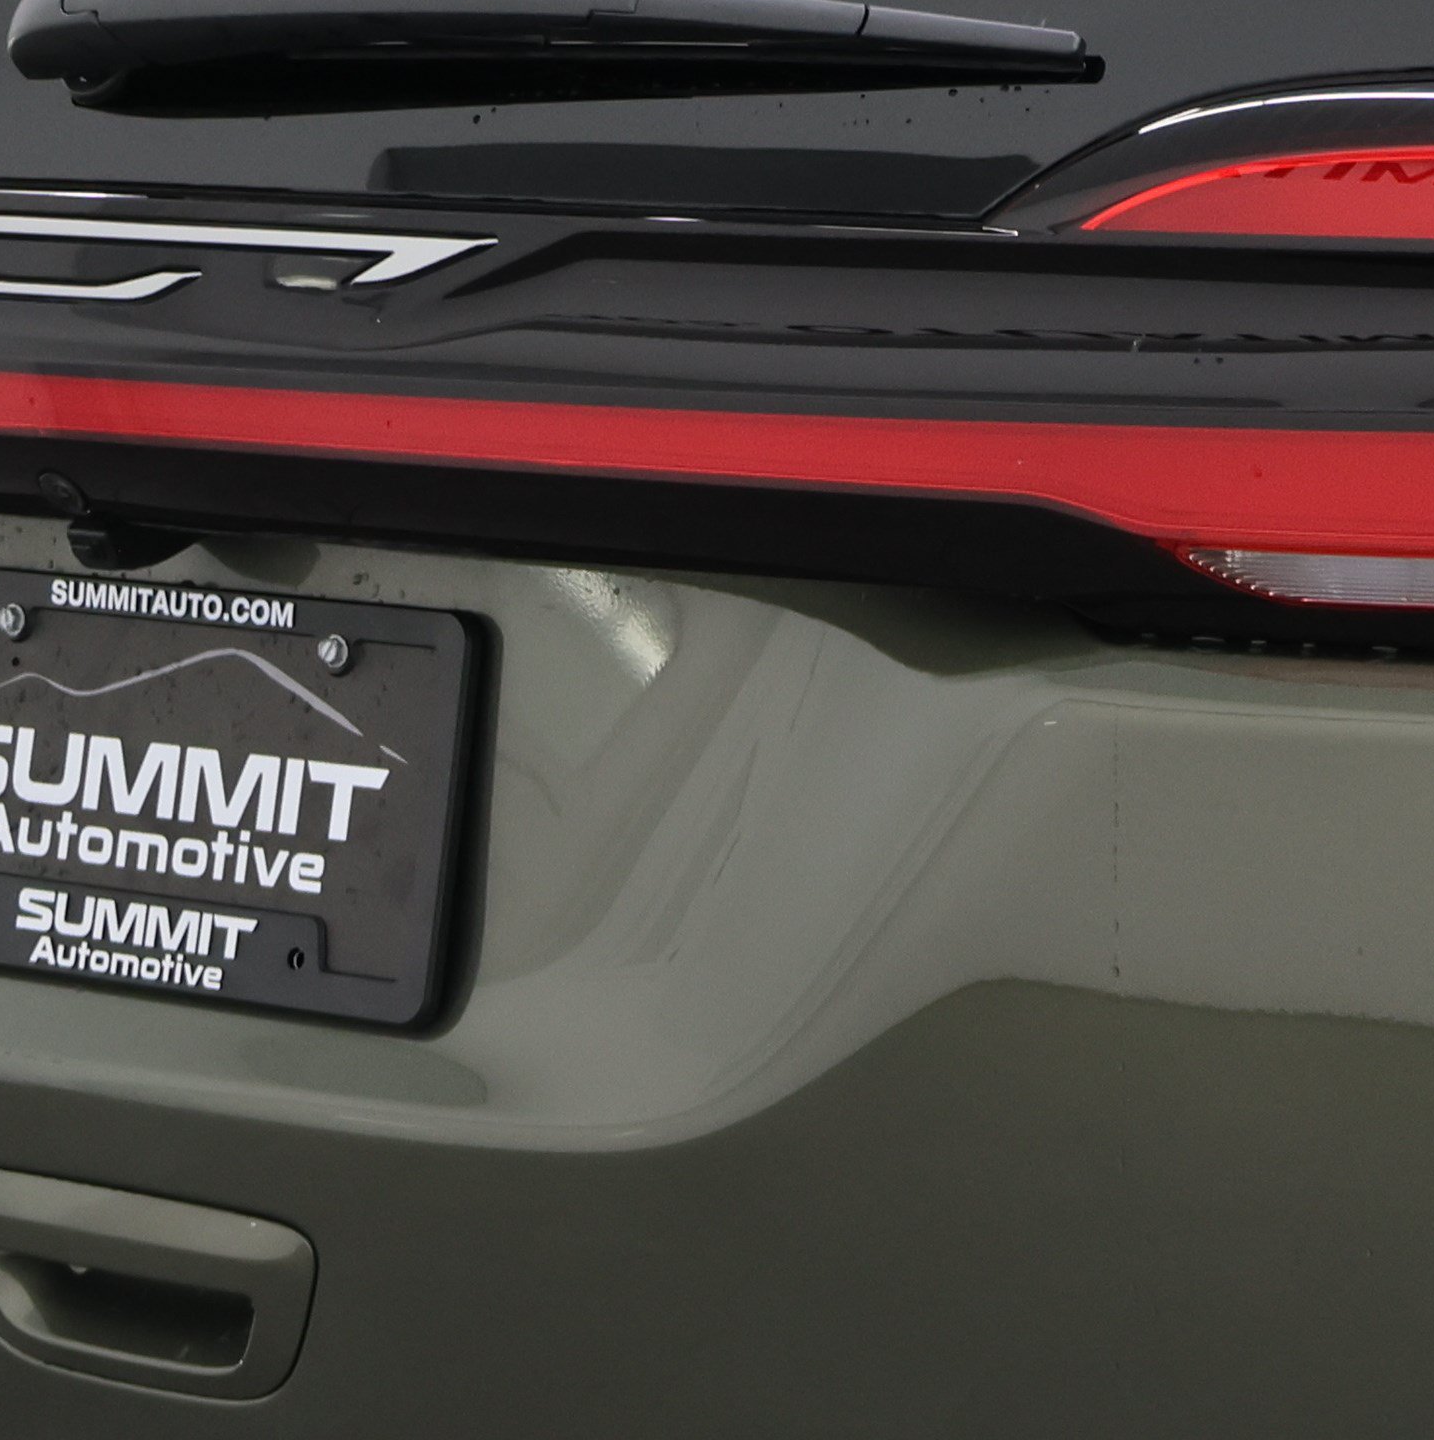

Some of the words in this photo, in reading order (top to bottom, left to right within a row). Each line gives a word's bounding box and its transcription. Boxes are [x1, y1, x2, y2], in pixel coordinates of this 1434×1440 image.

[50, 578, 295, 628] SUMMITAUTO.COM
[15, 887, 258, 961] SUMMIT
[29, 935, 224, 991] Automotive
